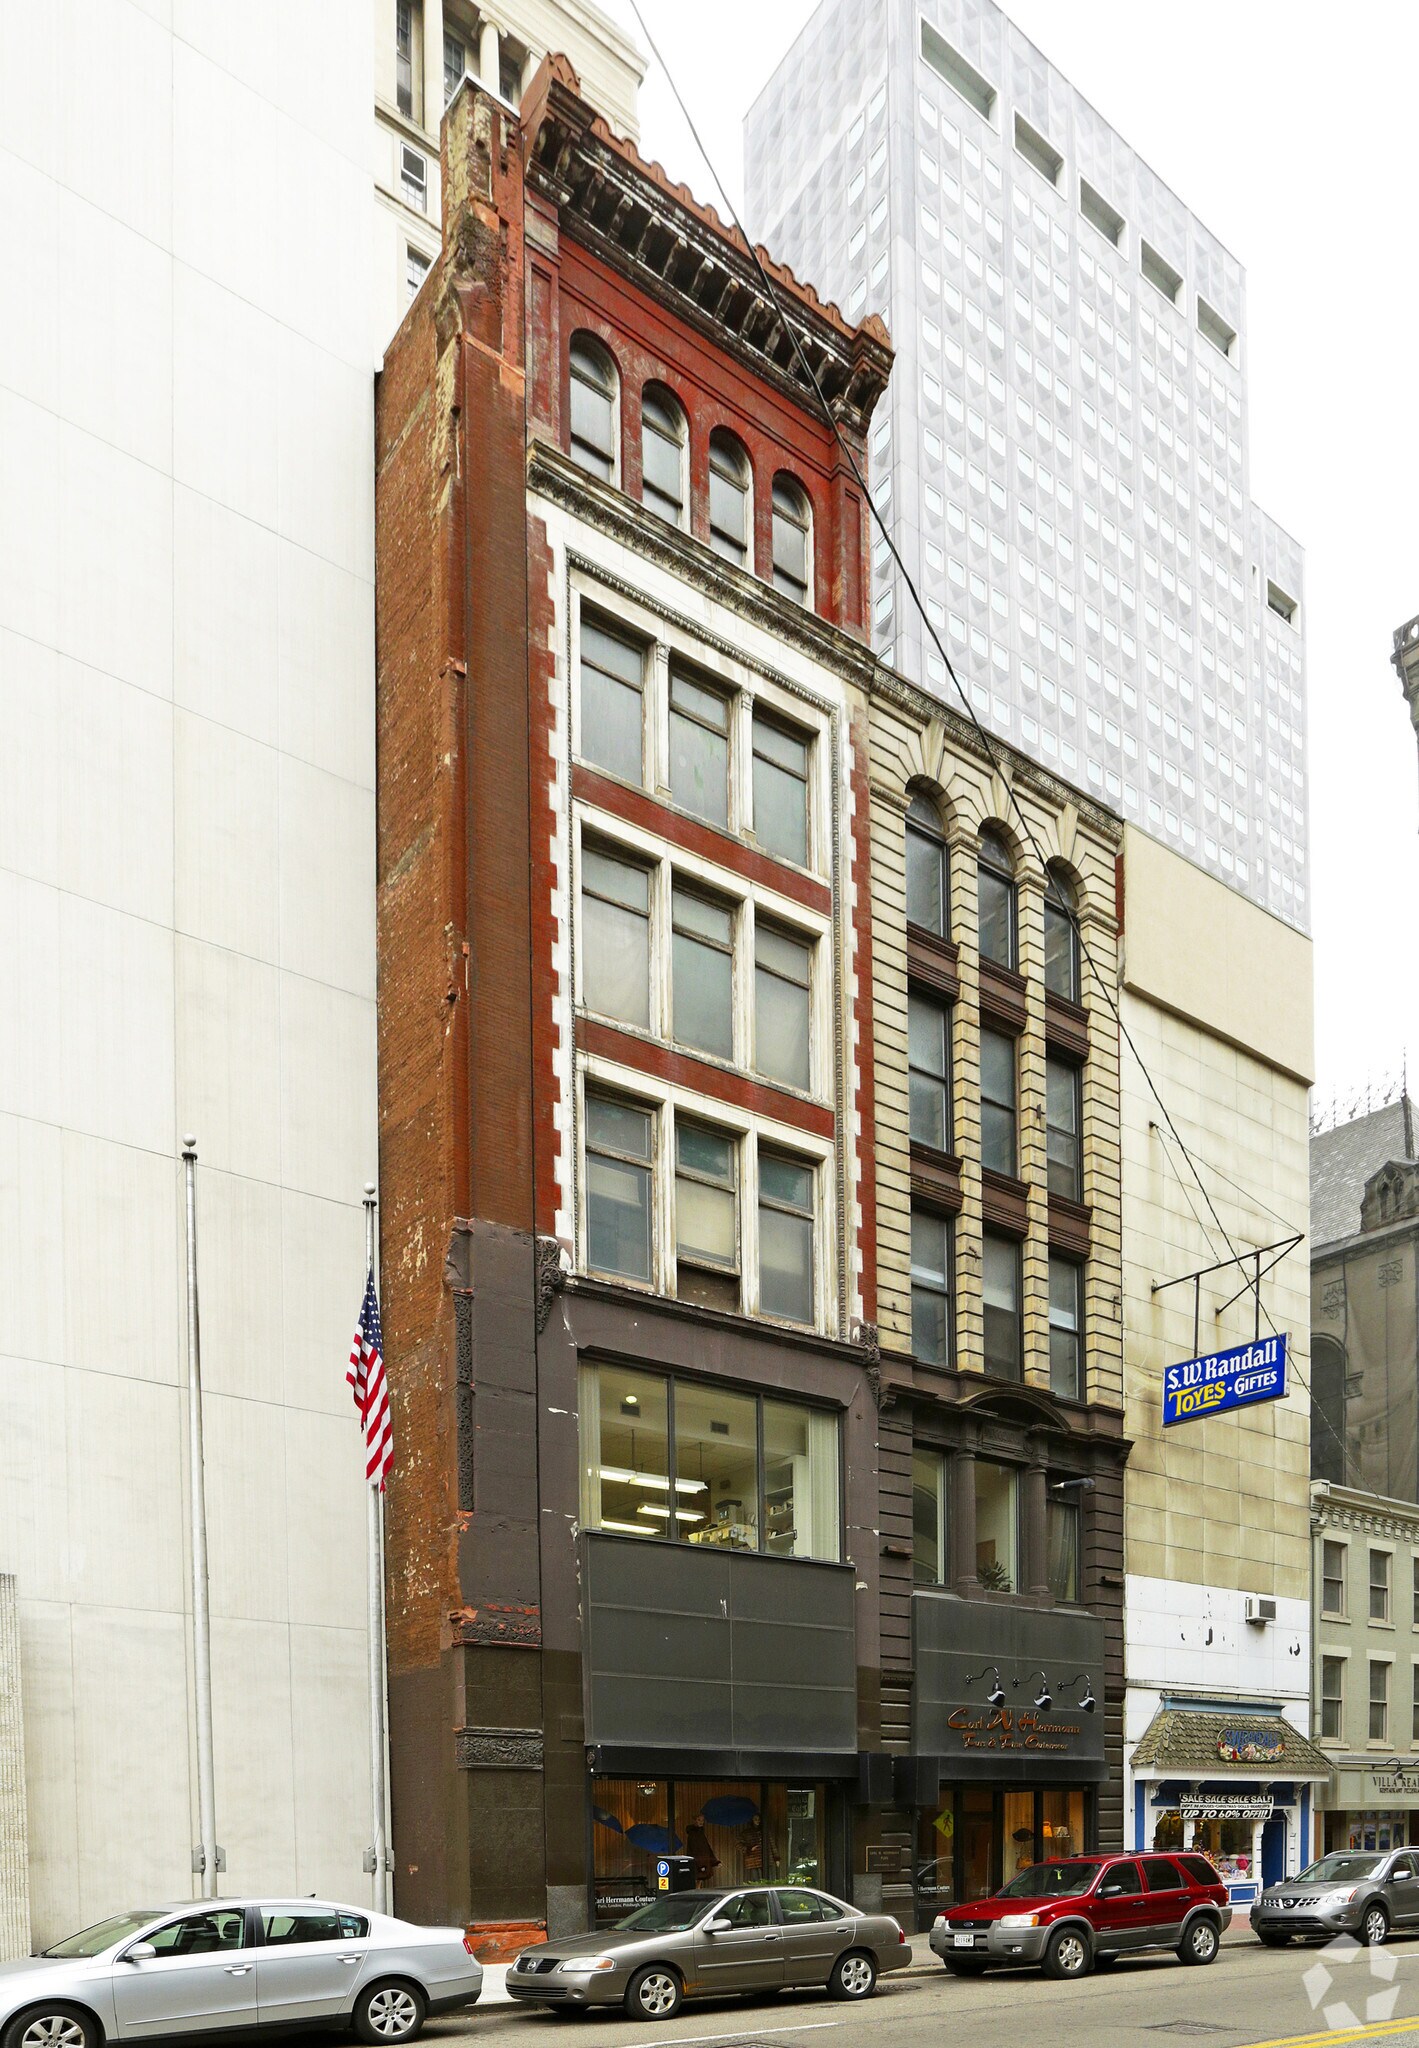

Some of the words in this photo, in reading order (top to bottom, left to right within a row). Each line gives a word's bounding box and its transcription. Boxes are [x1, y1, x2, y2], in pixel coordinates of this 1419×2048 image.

[1167, 1361, 1202, 1390] S.W.
[1205, 1340, 1277, 1380] Randall
[1234, 1371, 1277, 1394] GIFTES
[948, 1707, 983, 1729] Carl
[1372, 1776, 1397, 1787] VILLA
[1401, 1777, 1419, 1788] REA
[1181, 1794, 1203, 1803] SALE
[1204, 1795, 1226, 1803] SALE
[1228, 1795, 1249, 1804] SALE
[1182, 1809, 1199, 1818] UP
[1201, 1809, 1217, 1818] TO
[1218, 1810, 1240, 1818] 60%
[595, 1896, 605, 1904] arl
[606, 1896, 634, 1904] Herrmann
